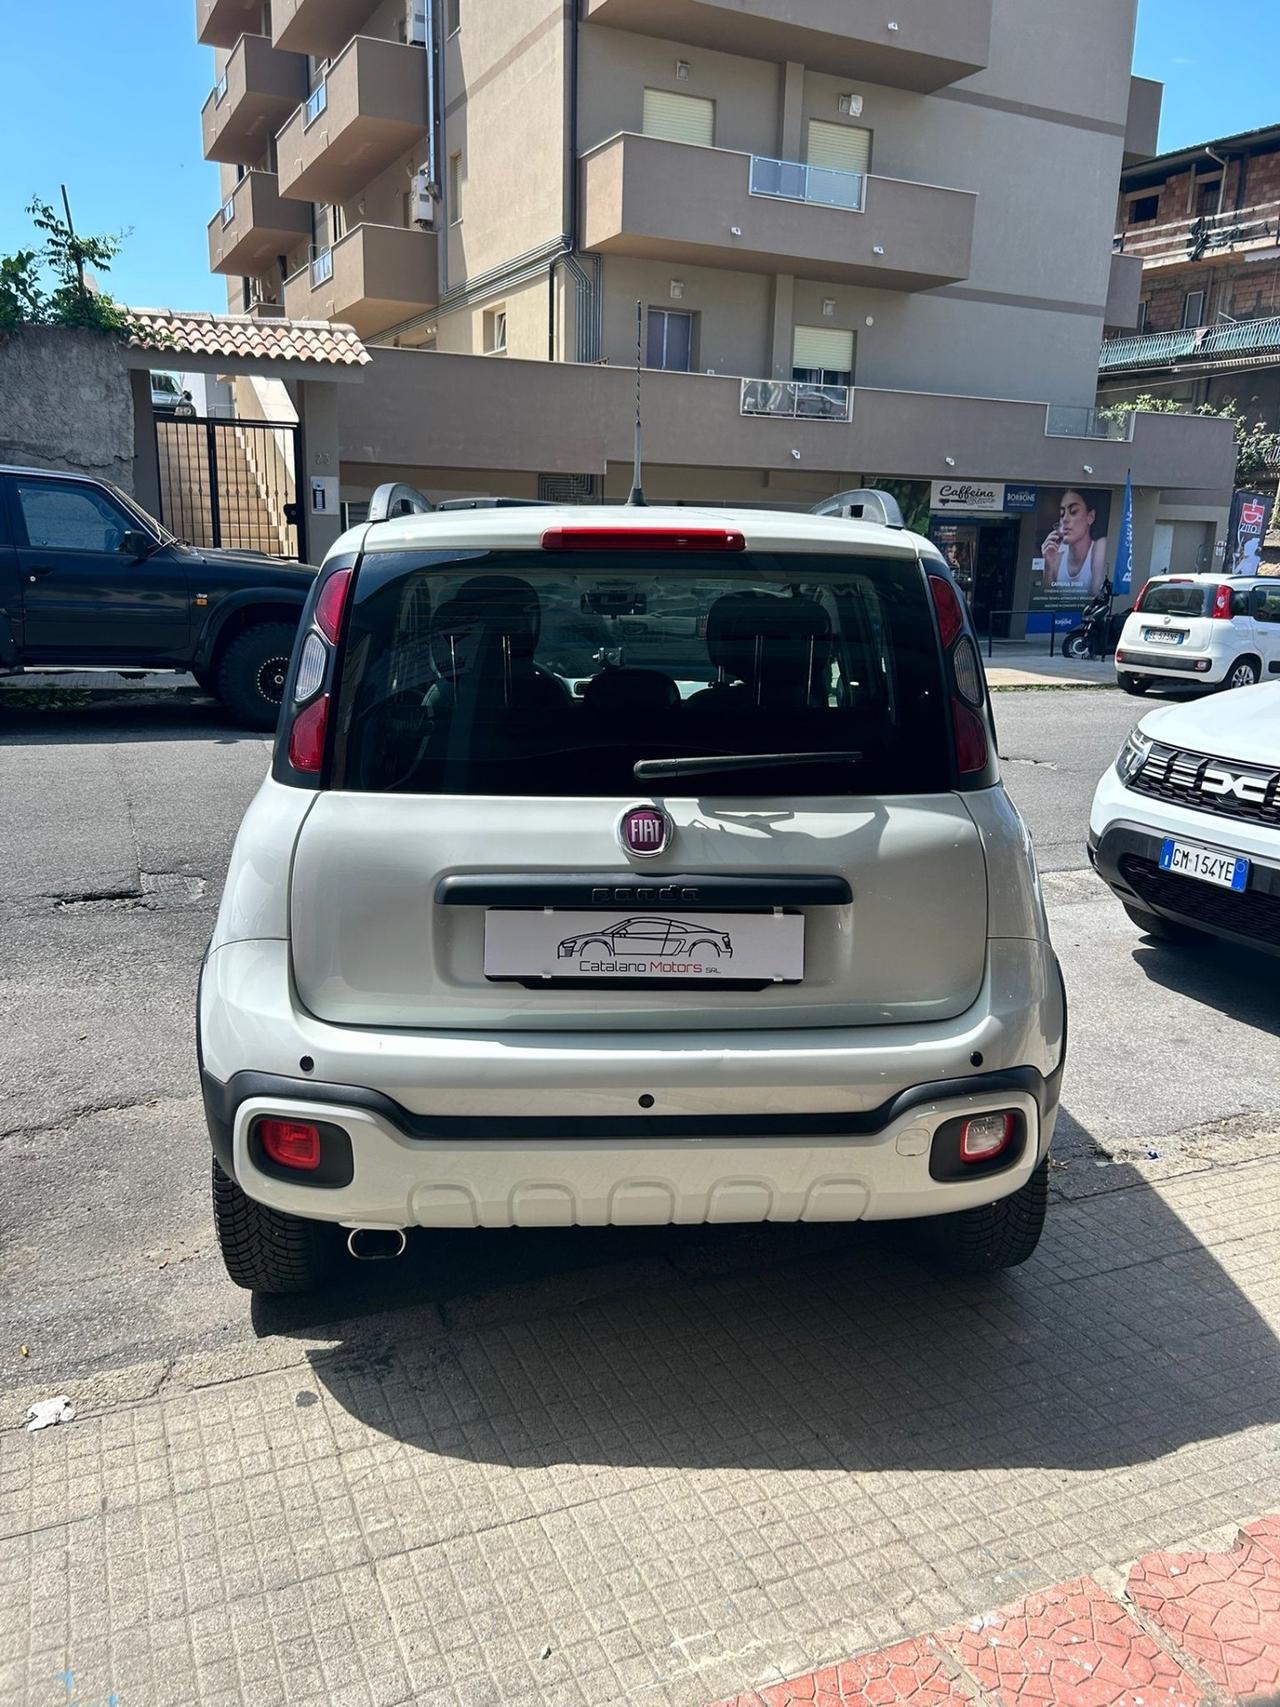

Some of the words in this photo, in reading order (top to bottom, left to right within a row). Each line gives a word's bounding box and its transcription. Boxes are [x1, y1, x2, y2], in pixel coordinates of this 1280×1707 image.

[940, 485, 996, 499] Caffeina
[631, 819, 661, 842] FIAT
[1173, 848, 1190, 869] GM
[1194, 854, 1234, 881] 154YE
[579, 960, 646, 973] Catalano
[650, 961, 702, 973] Motors
